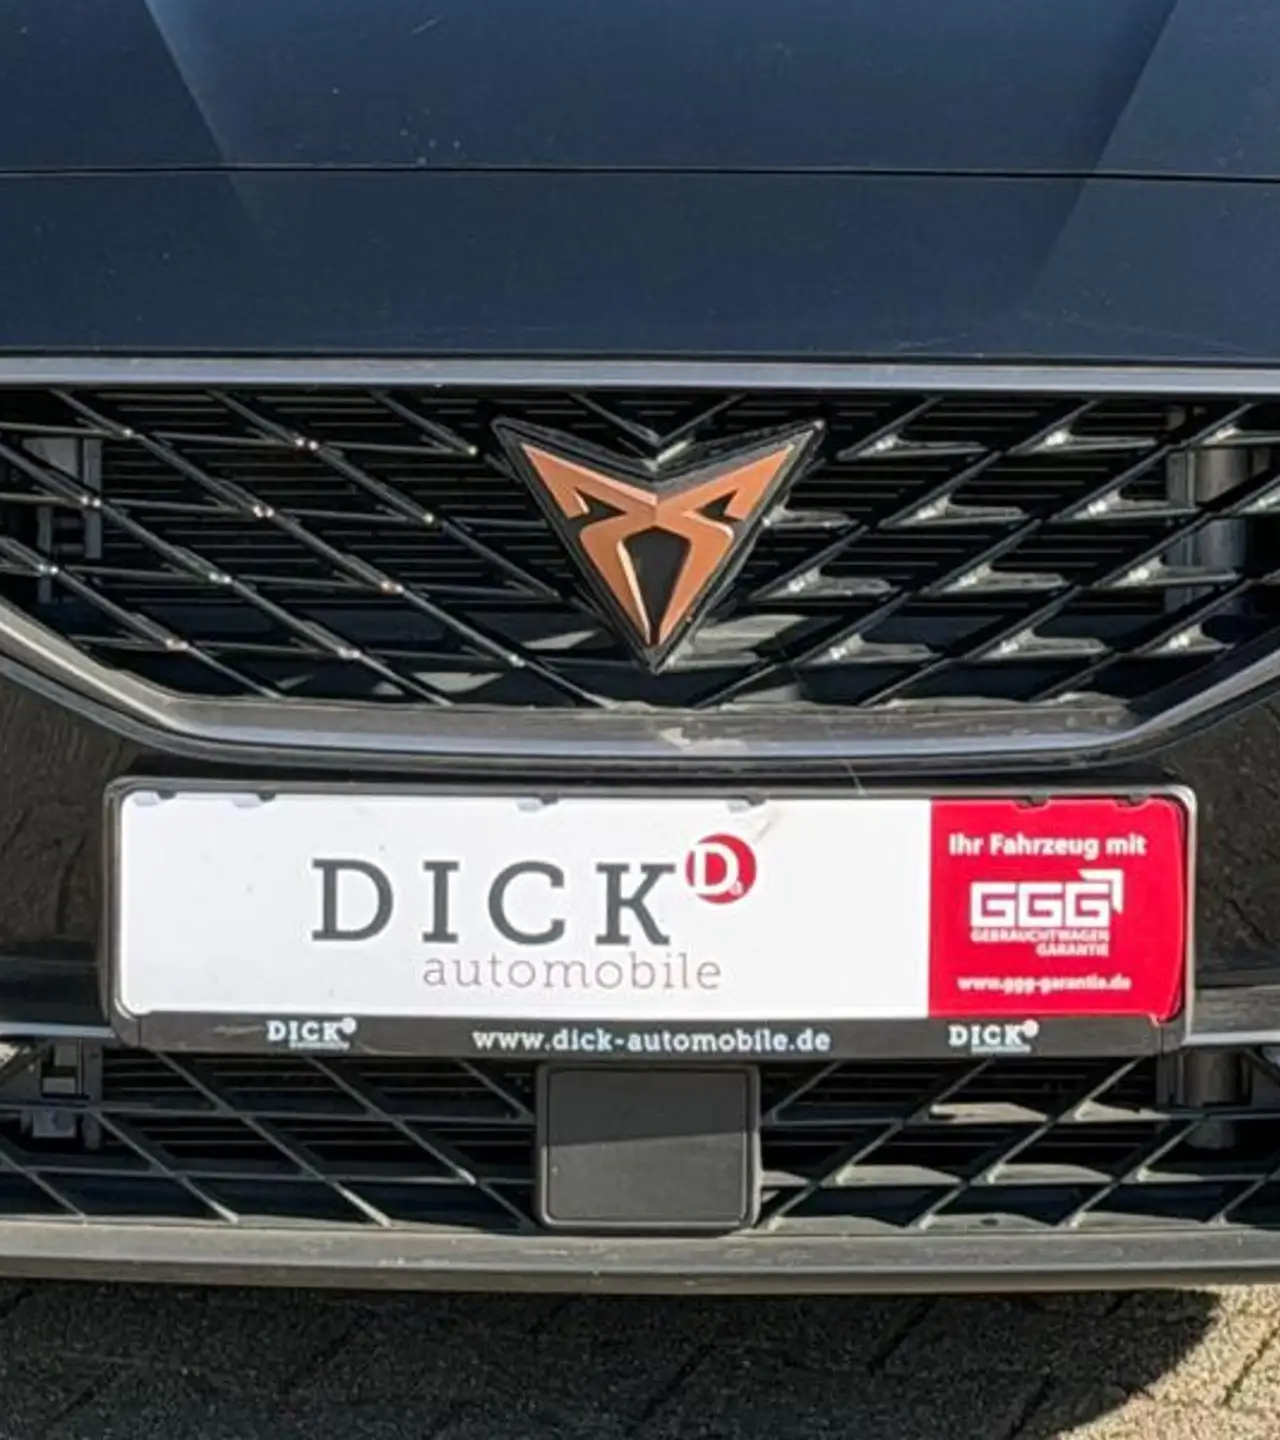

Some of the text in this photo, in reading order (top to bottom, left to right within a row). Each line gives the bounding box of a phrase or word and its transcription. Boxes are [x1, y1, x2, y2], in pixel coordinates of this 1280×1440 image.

[949, 833, 1147, 861] Ihr Fahrzeug mit
[312, 859, 677, 946] DICK
[970, 881, 1111, 928] GGG
[1036, 943, 1109, 957] GARANTIE
[423, 953, 721, 990] automobile
[957, 973, 1132, 994] www.ggg-garantie.de
[266, 1019, 339, 1042] DICK
[471, 1028, 832, 1052] www.dick-automobile.de
[948, 1024, 1022, 1047] DICK
